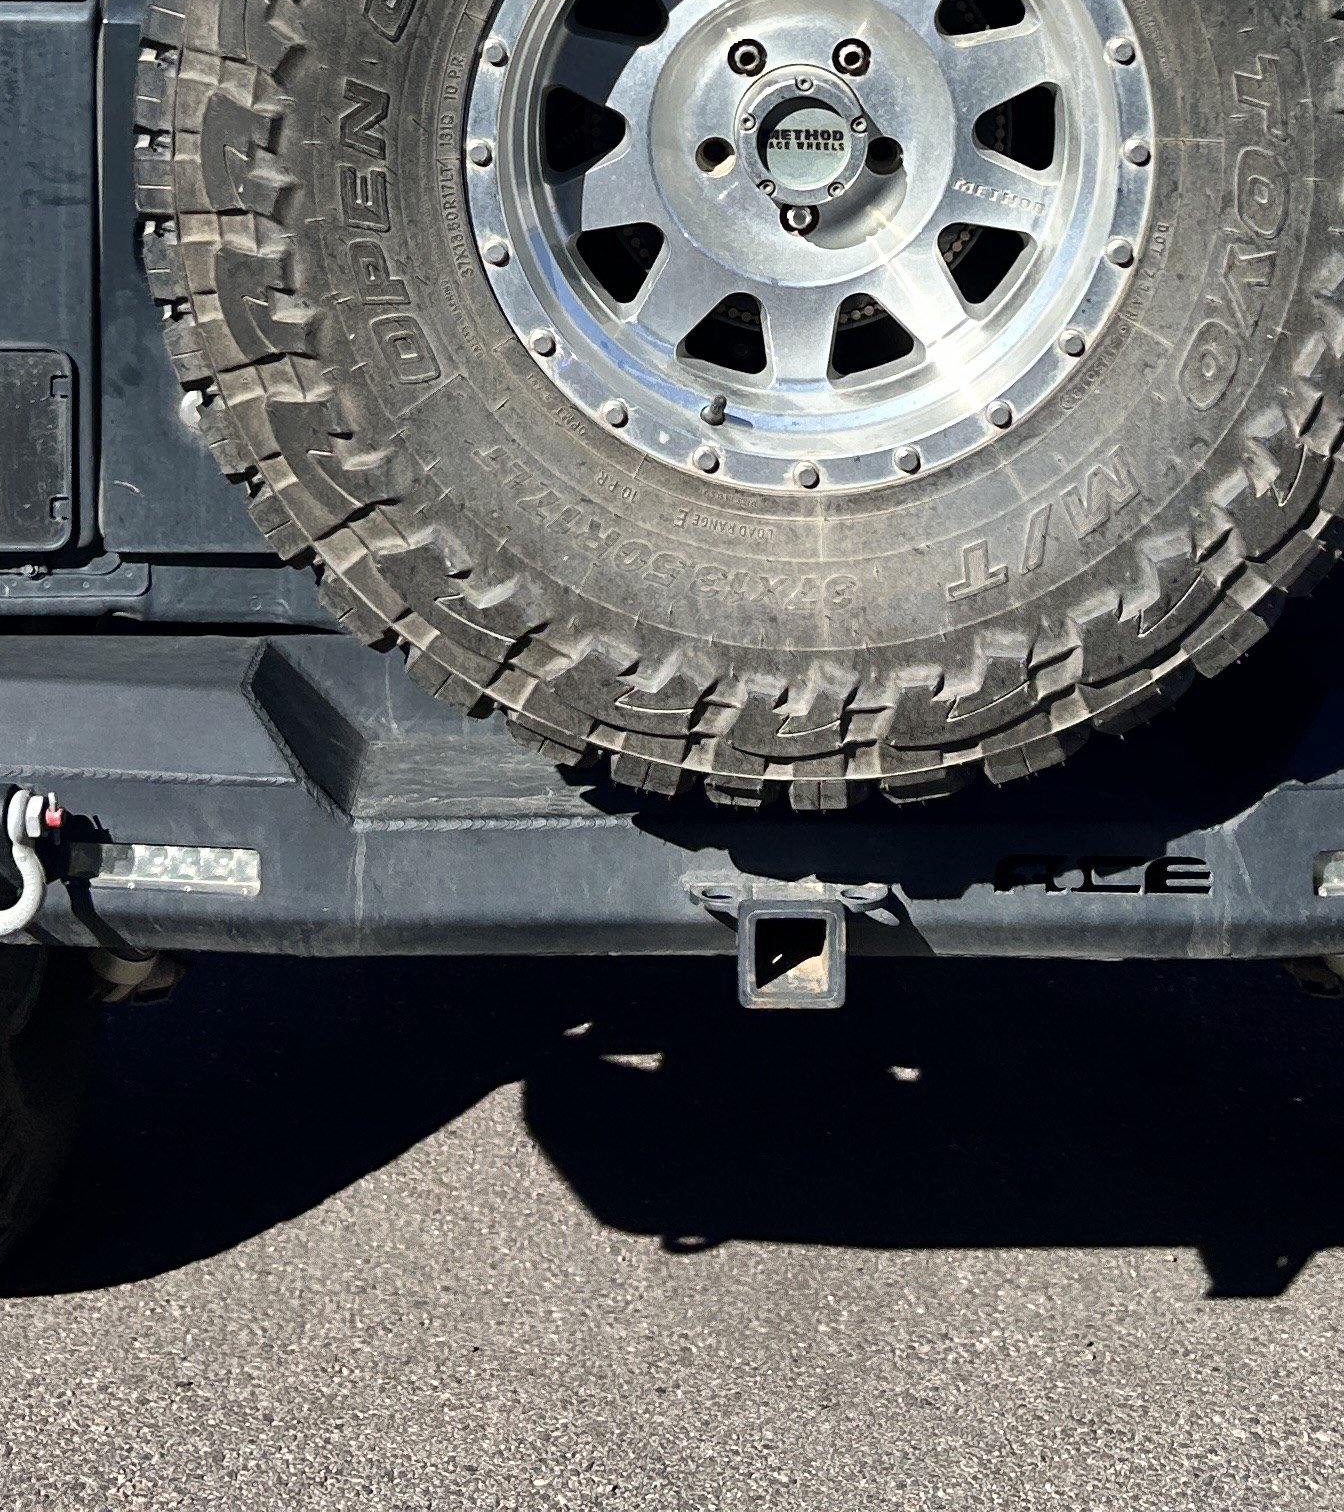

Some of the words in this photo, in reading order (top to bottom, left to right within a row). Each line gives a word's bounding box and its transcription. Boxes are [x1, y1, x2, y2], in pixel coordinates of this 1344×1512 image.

[796, 141, 845, 151] WHEELS
[339, 76, 443, 384] OPEN
[1177, 52, 1290, 411] TOYO
[673, 508, 688, 528] E
[691, 513, 736, 535] RANGE
[945, 444, 1142, 603] M/T
[738, 524, 773, 540] LOAD
